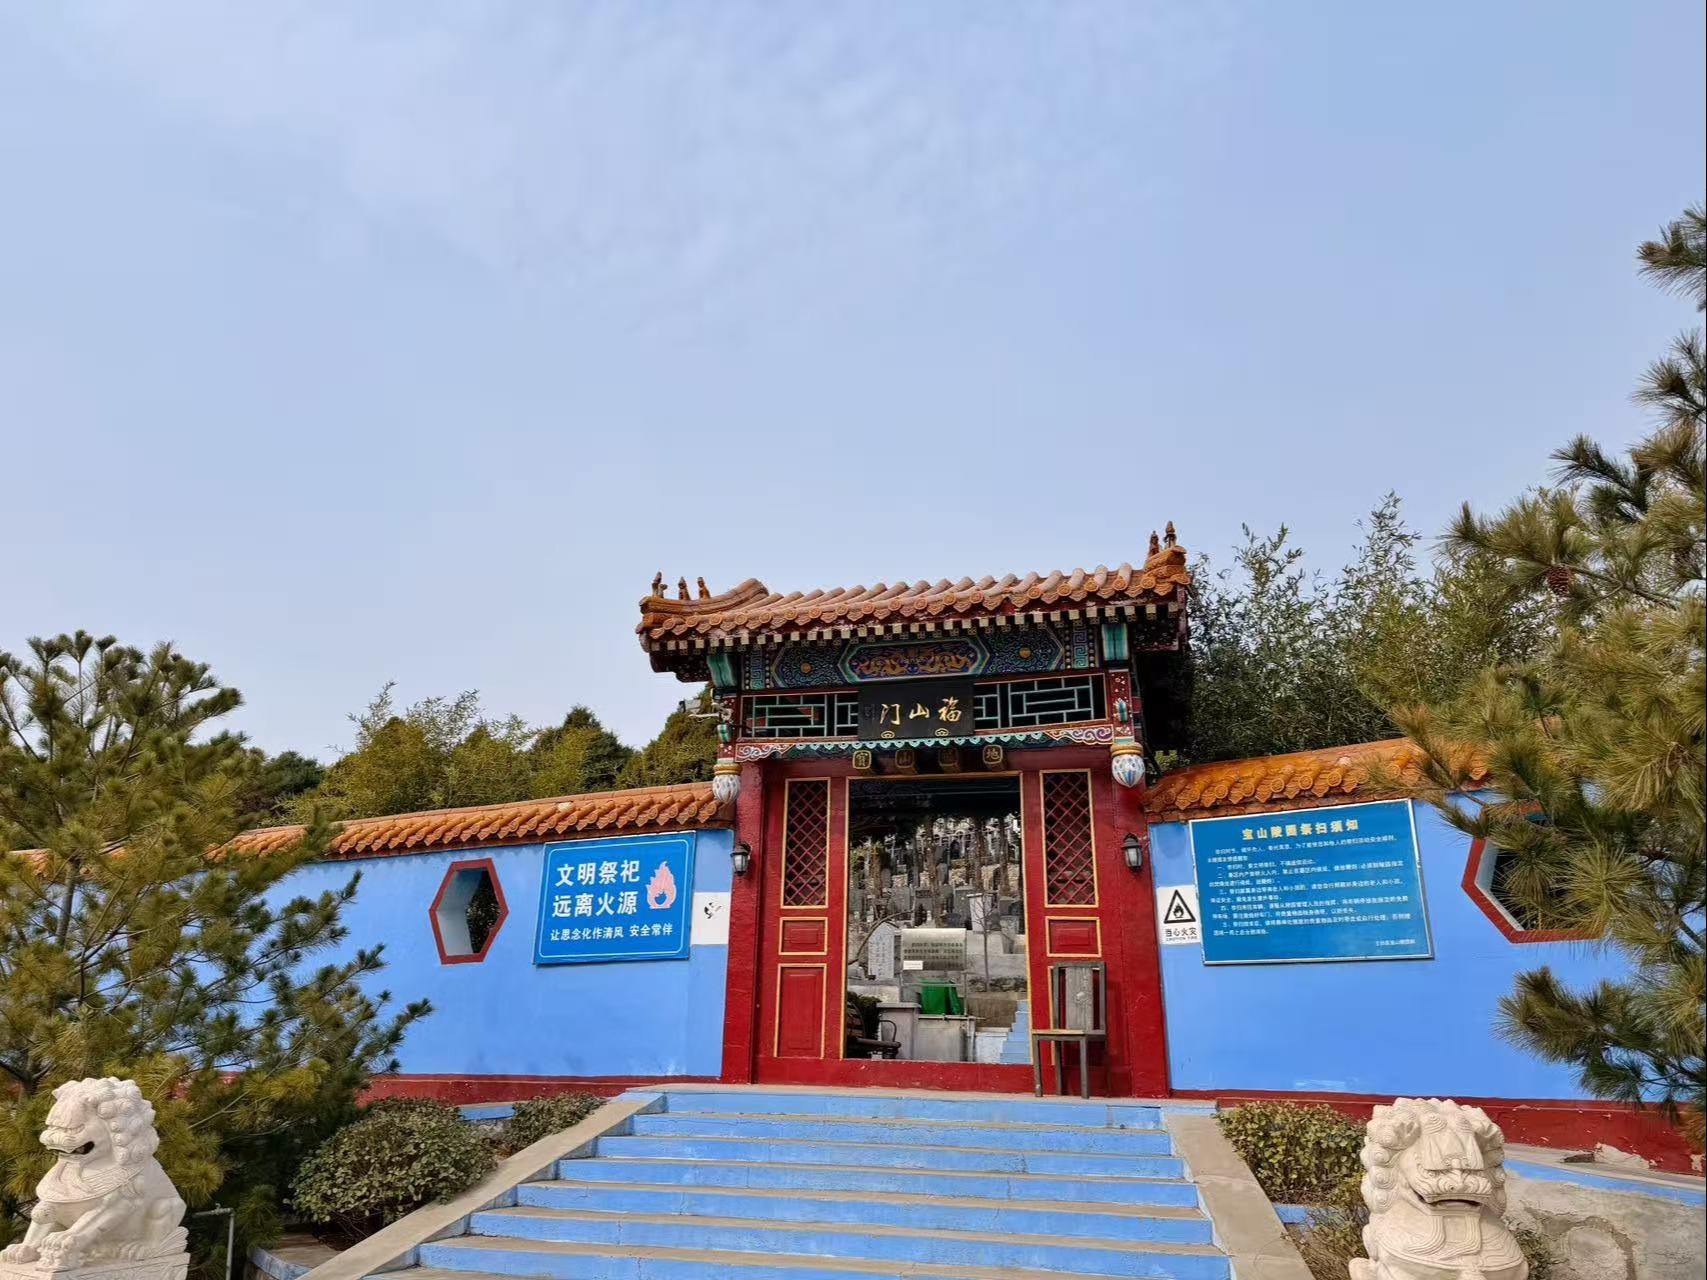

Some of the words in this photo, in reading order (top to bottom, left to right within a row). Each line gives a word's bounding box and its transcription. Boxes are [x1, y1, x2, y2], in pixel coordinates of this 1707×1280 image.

[1242, 819, 1359, 841] 宝山陵园祭扫须知
[555, 860, 640, 887] 文明祭祀
[552, 891, 638, 917] 远离火源
[551, 926, 624, 941] 让思念化作清风
[629, 922, 673, 937] 安全常伴
